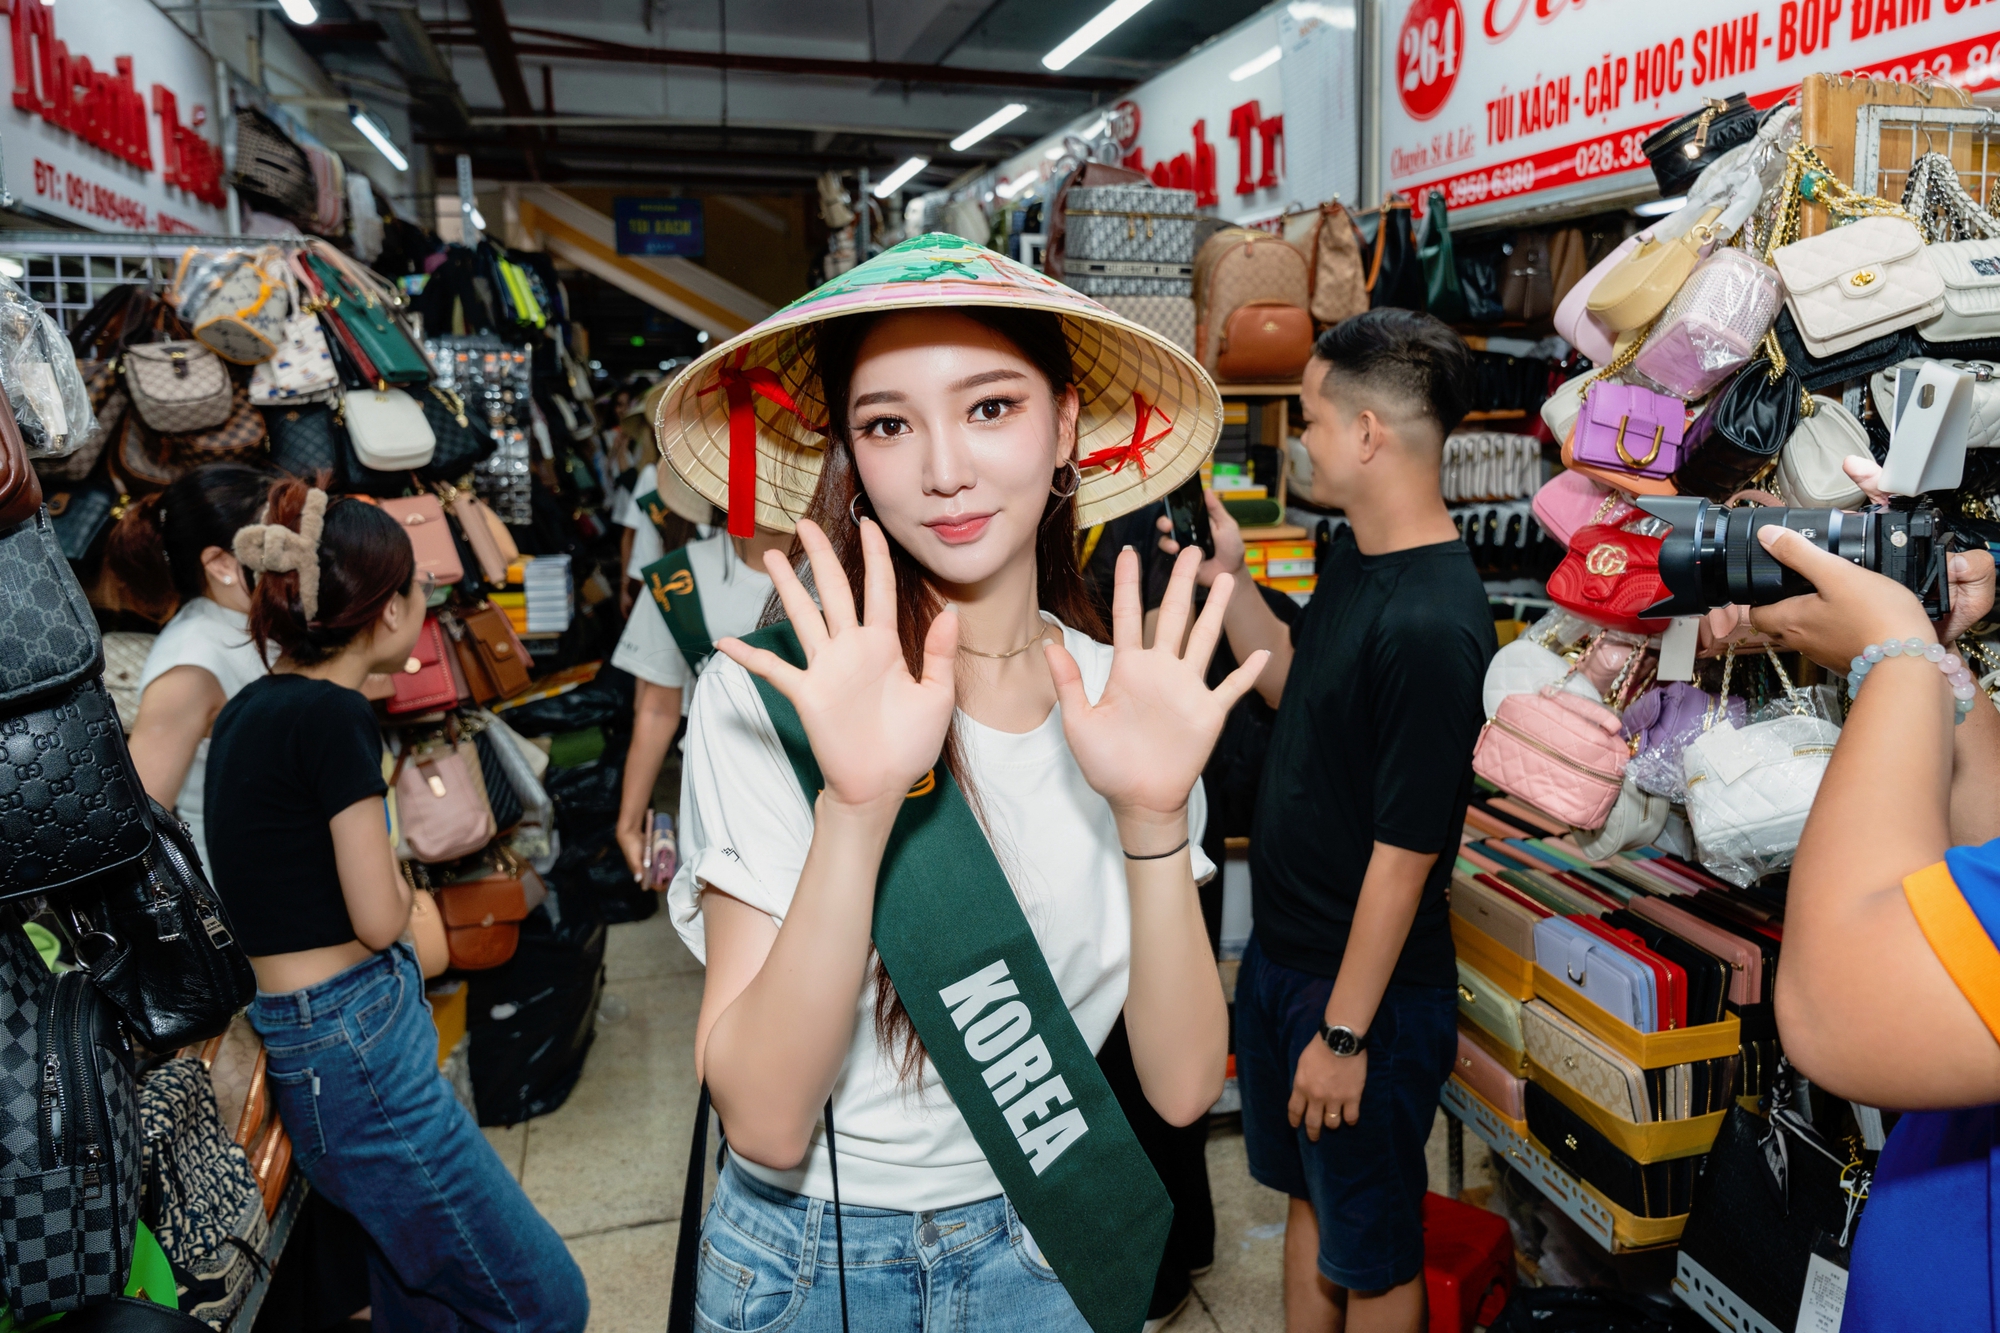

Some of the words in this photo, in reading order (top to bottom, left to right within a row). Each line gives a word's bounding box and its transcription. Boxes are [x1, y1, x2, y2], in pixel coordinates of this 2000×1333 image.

[1402, 7, 1459, 92] 264
[1486, 84, 1514, 146] TÚI
[1518, 72, 1571, 137] XÁCH
[1634, 36, 1684, 111] HỌC
[1690, 13, 1760, 87] SINH
[1229, 100, 1286, 196] Tr
[1576, 125, 1661, 177] 028.38
[938, 959, 1089, 1177] KOREA
